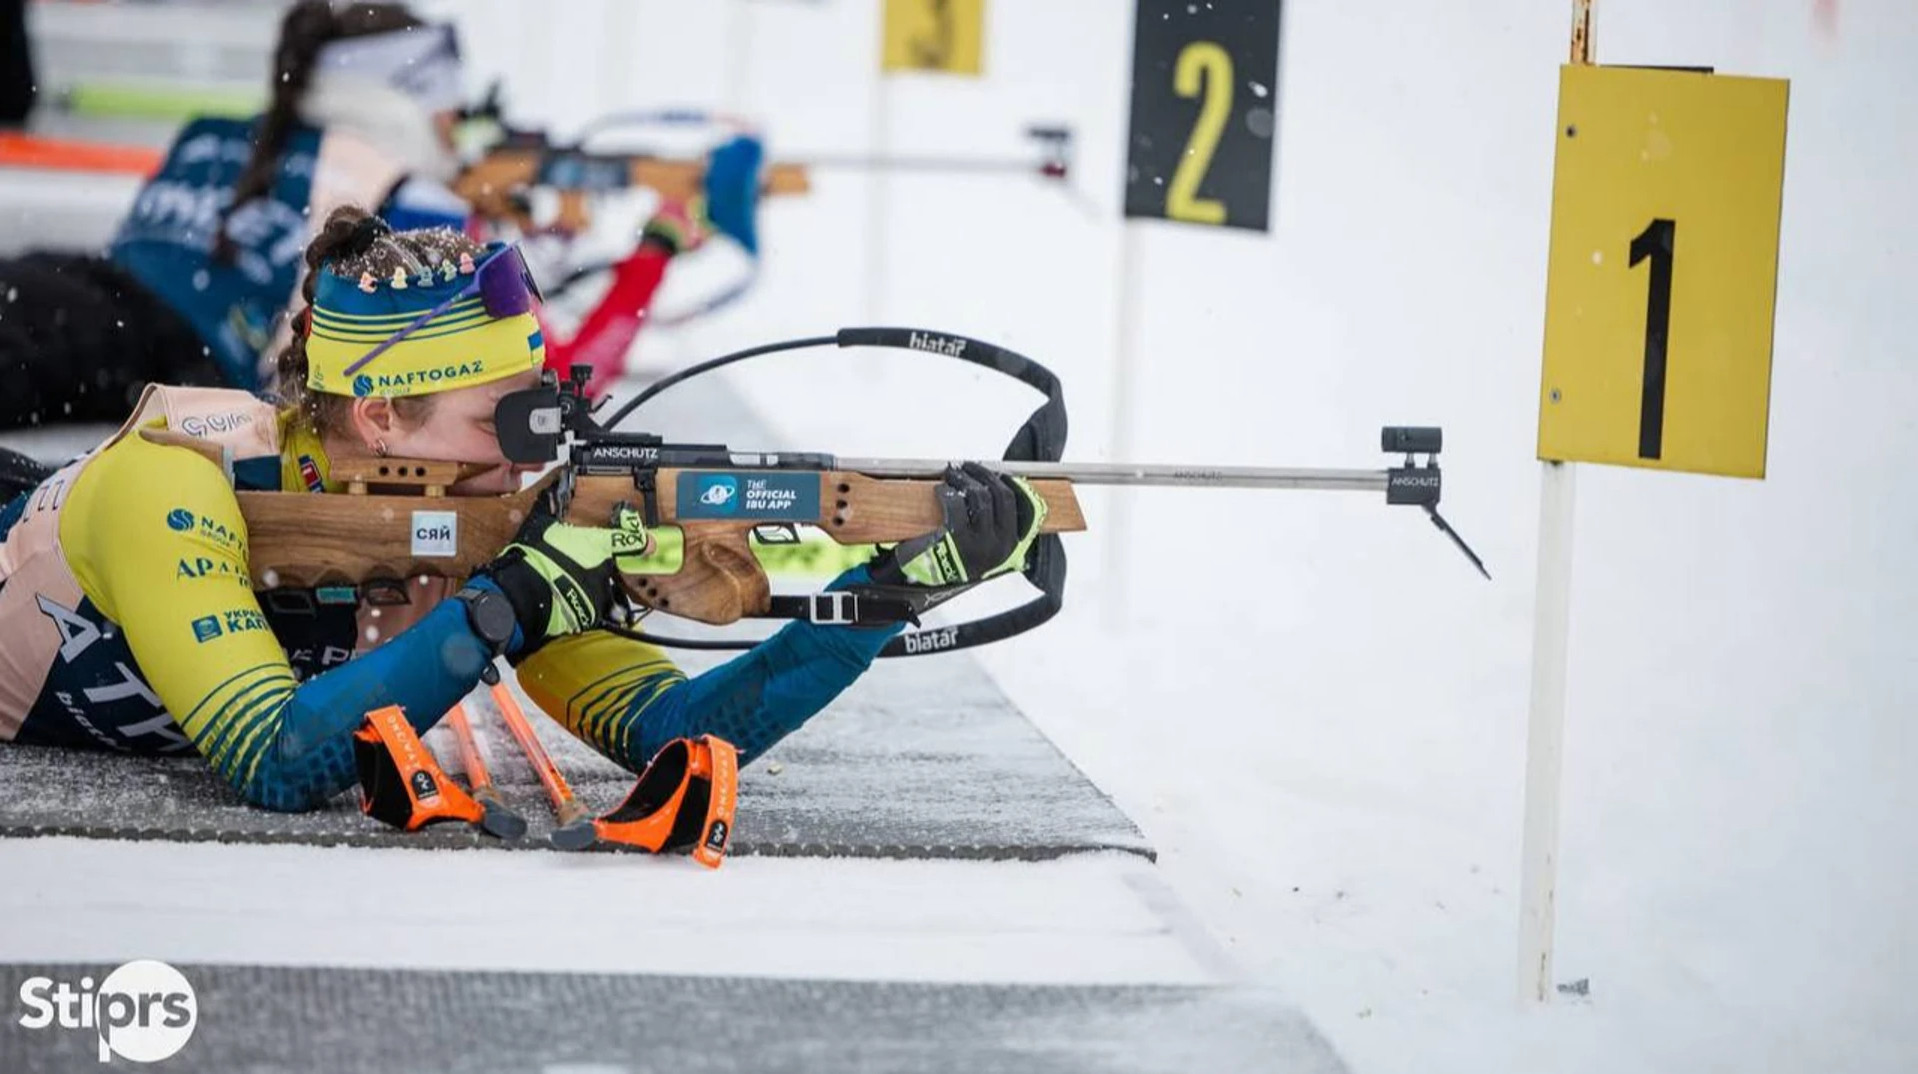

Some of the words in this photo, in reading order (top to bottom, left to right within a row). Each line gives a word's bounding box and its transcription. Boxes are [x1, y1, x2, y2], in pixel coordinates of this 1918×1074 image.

[1165, 41, 1234, 225] 2
[1628, 217, 1676, 461] 1
[378, 360, 483, 387] NAFTOGAZ
[747, 479, 767, 490] THE
[746, 489, 797, 500] OFFICIAL
[746, 499, 767, 510] IBU
[767, 499, 792, 510] APP
[416, 525, 451, 541] СЯЙ
